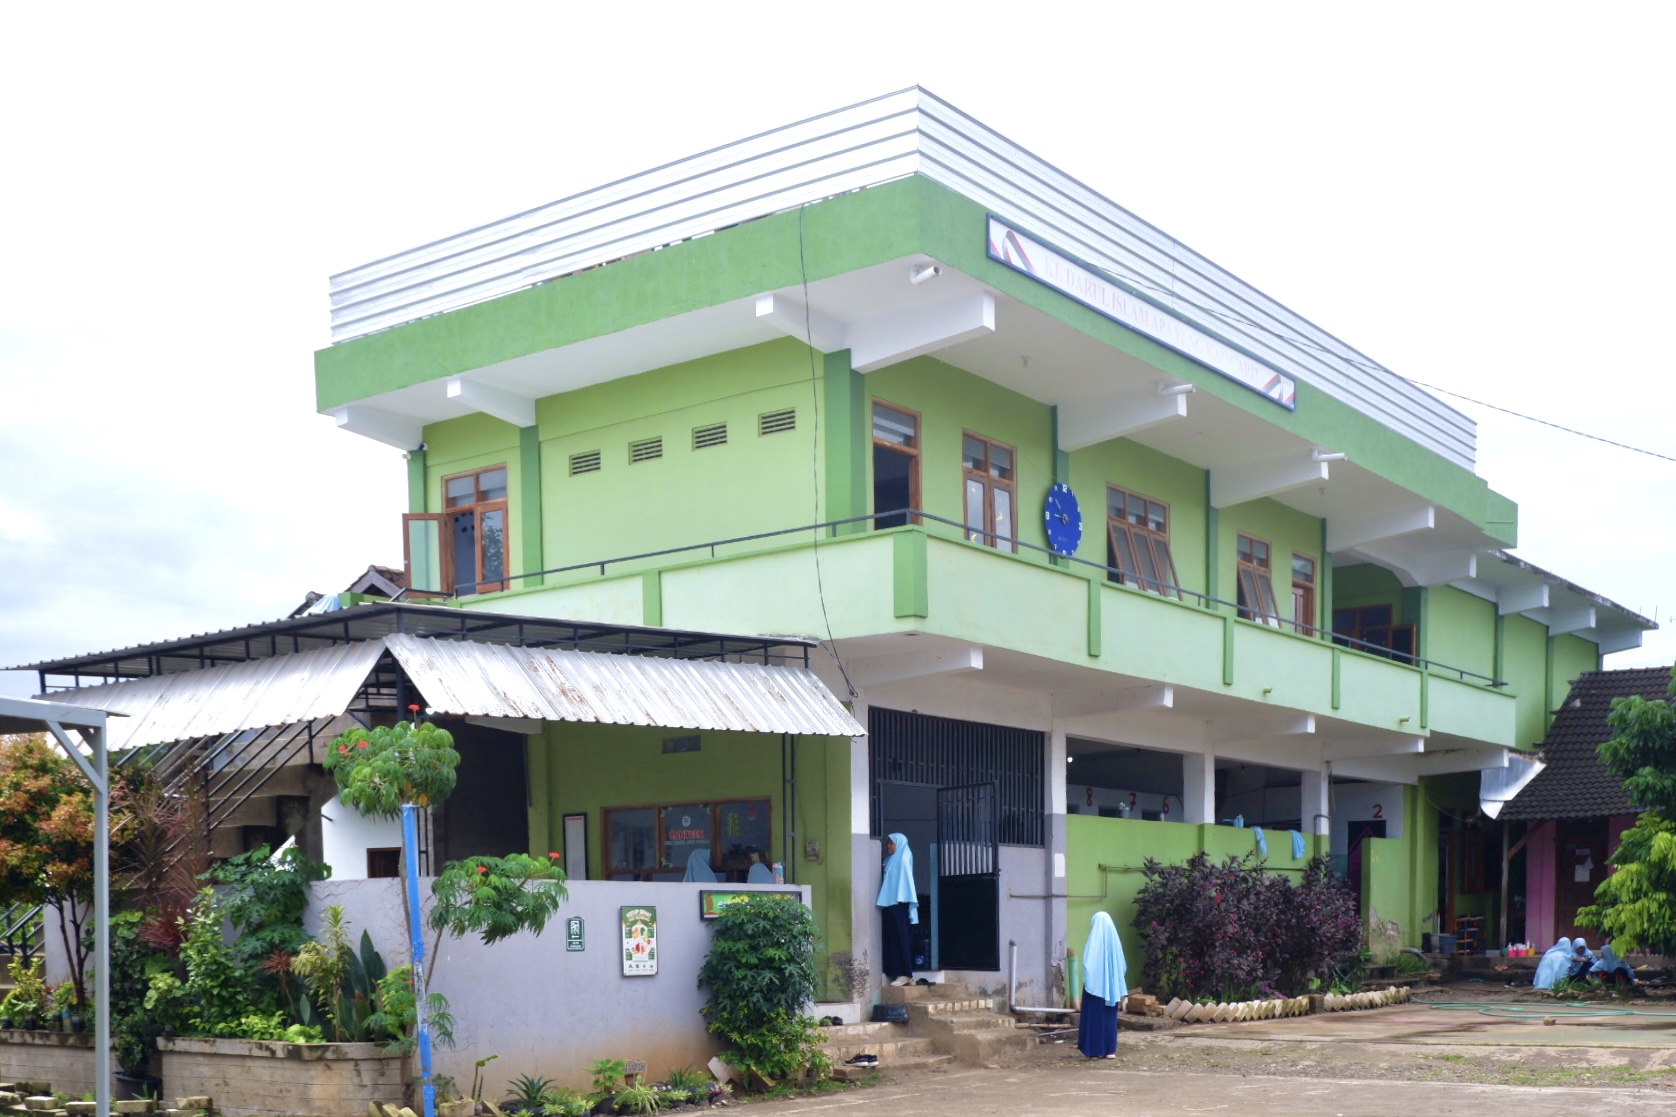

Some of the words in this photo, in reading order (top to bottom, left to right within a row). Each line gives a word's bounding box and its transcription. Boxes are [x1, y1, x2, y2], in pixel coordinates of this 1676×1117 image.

[1066, 267, 1109, 306] DARUL
[1112, 292, 1149, 327] ISLAM
[1151, 314, 1173, 337] APA
[1045, 511, 1050, 520] 9
[1086, 787, 1093, 807] 8
[1128, 792, 1137, 812] 7
[1163, 795, 1169, 814] 6
[1372, 804, 1383, 819] 2
[668, 829, 705, 841] CANTEEN
